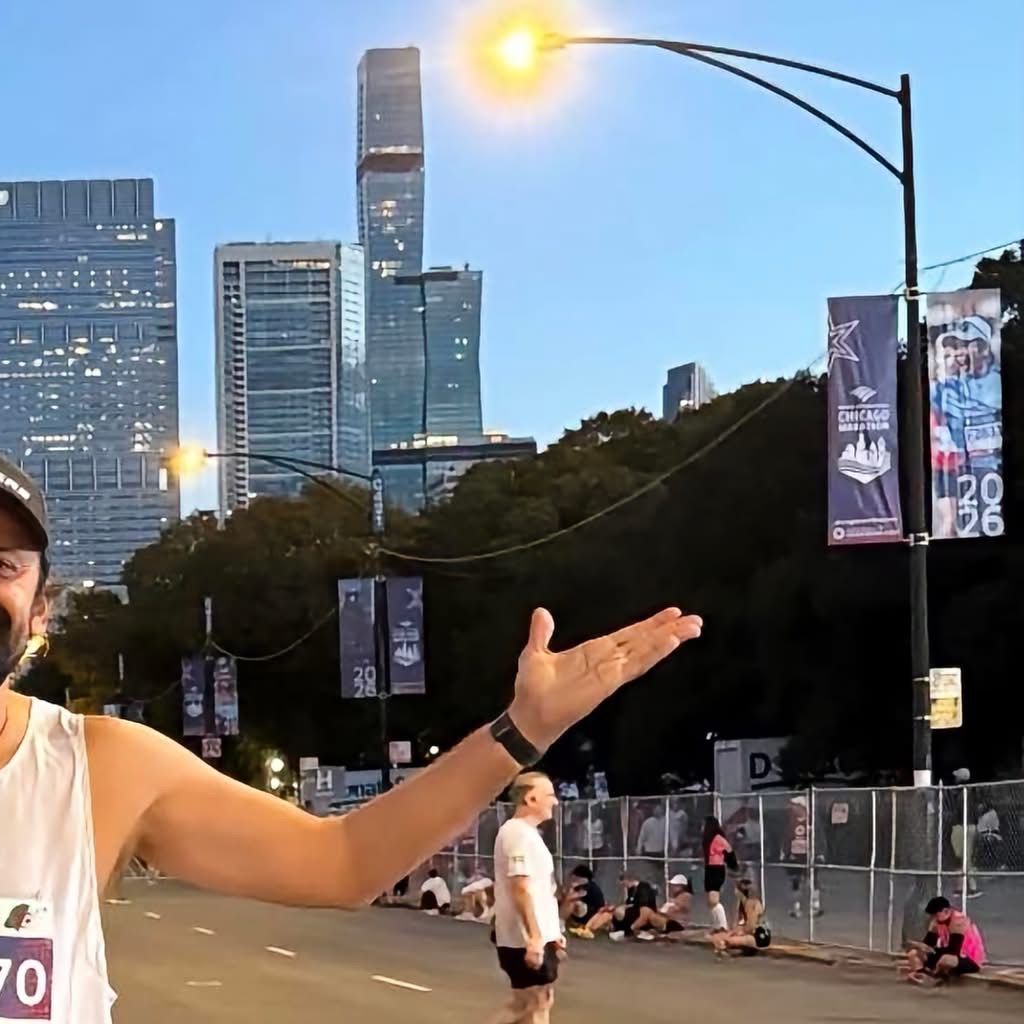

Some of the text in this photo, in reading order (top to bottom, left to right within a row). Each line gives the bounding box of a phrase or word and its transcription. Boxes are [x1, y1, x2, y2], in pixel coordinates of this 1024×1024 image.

[838, 409, 890, 422] CHICAGO
[957, 472, 1004, 506] 20
[957, 504, 1005, 537] 26
[749, 752, 772, 779] D
[317, 769, 333, 790] H
